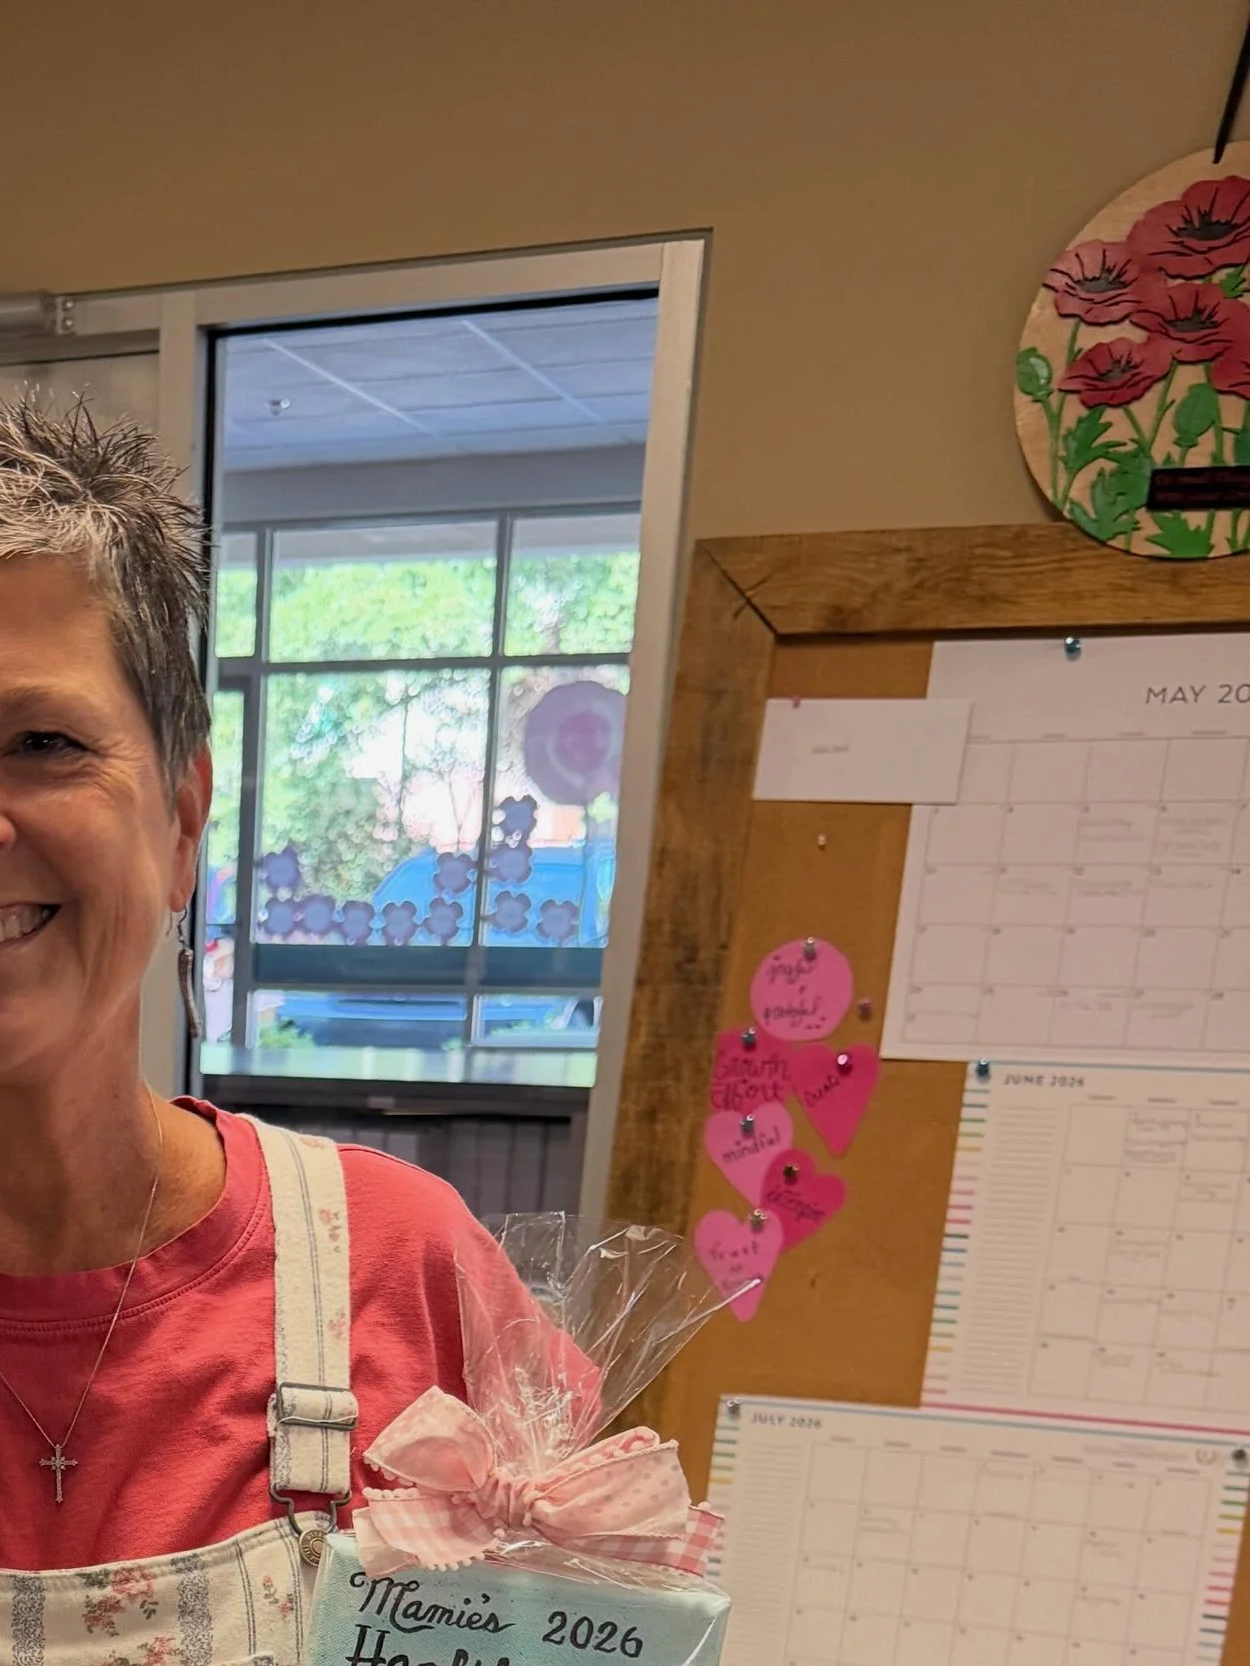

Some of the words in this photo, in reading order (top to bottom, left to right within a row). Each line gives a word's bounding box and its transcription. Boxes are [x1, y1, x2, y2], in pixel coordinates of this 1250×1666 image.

[1145, 685, 1206, 704] MAY
[1002, 1073, 1046, 1087] JUNE
[751, 1411, 786, 1426] JULY
[350, 1571, 516, 1634] Mamie's
[542, 1611, 643, 1658] 2026
